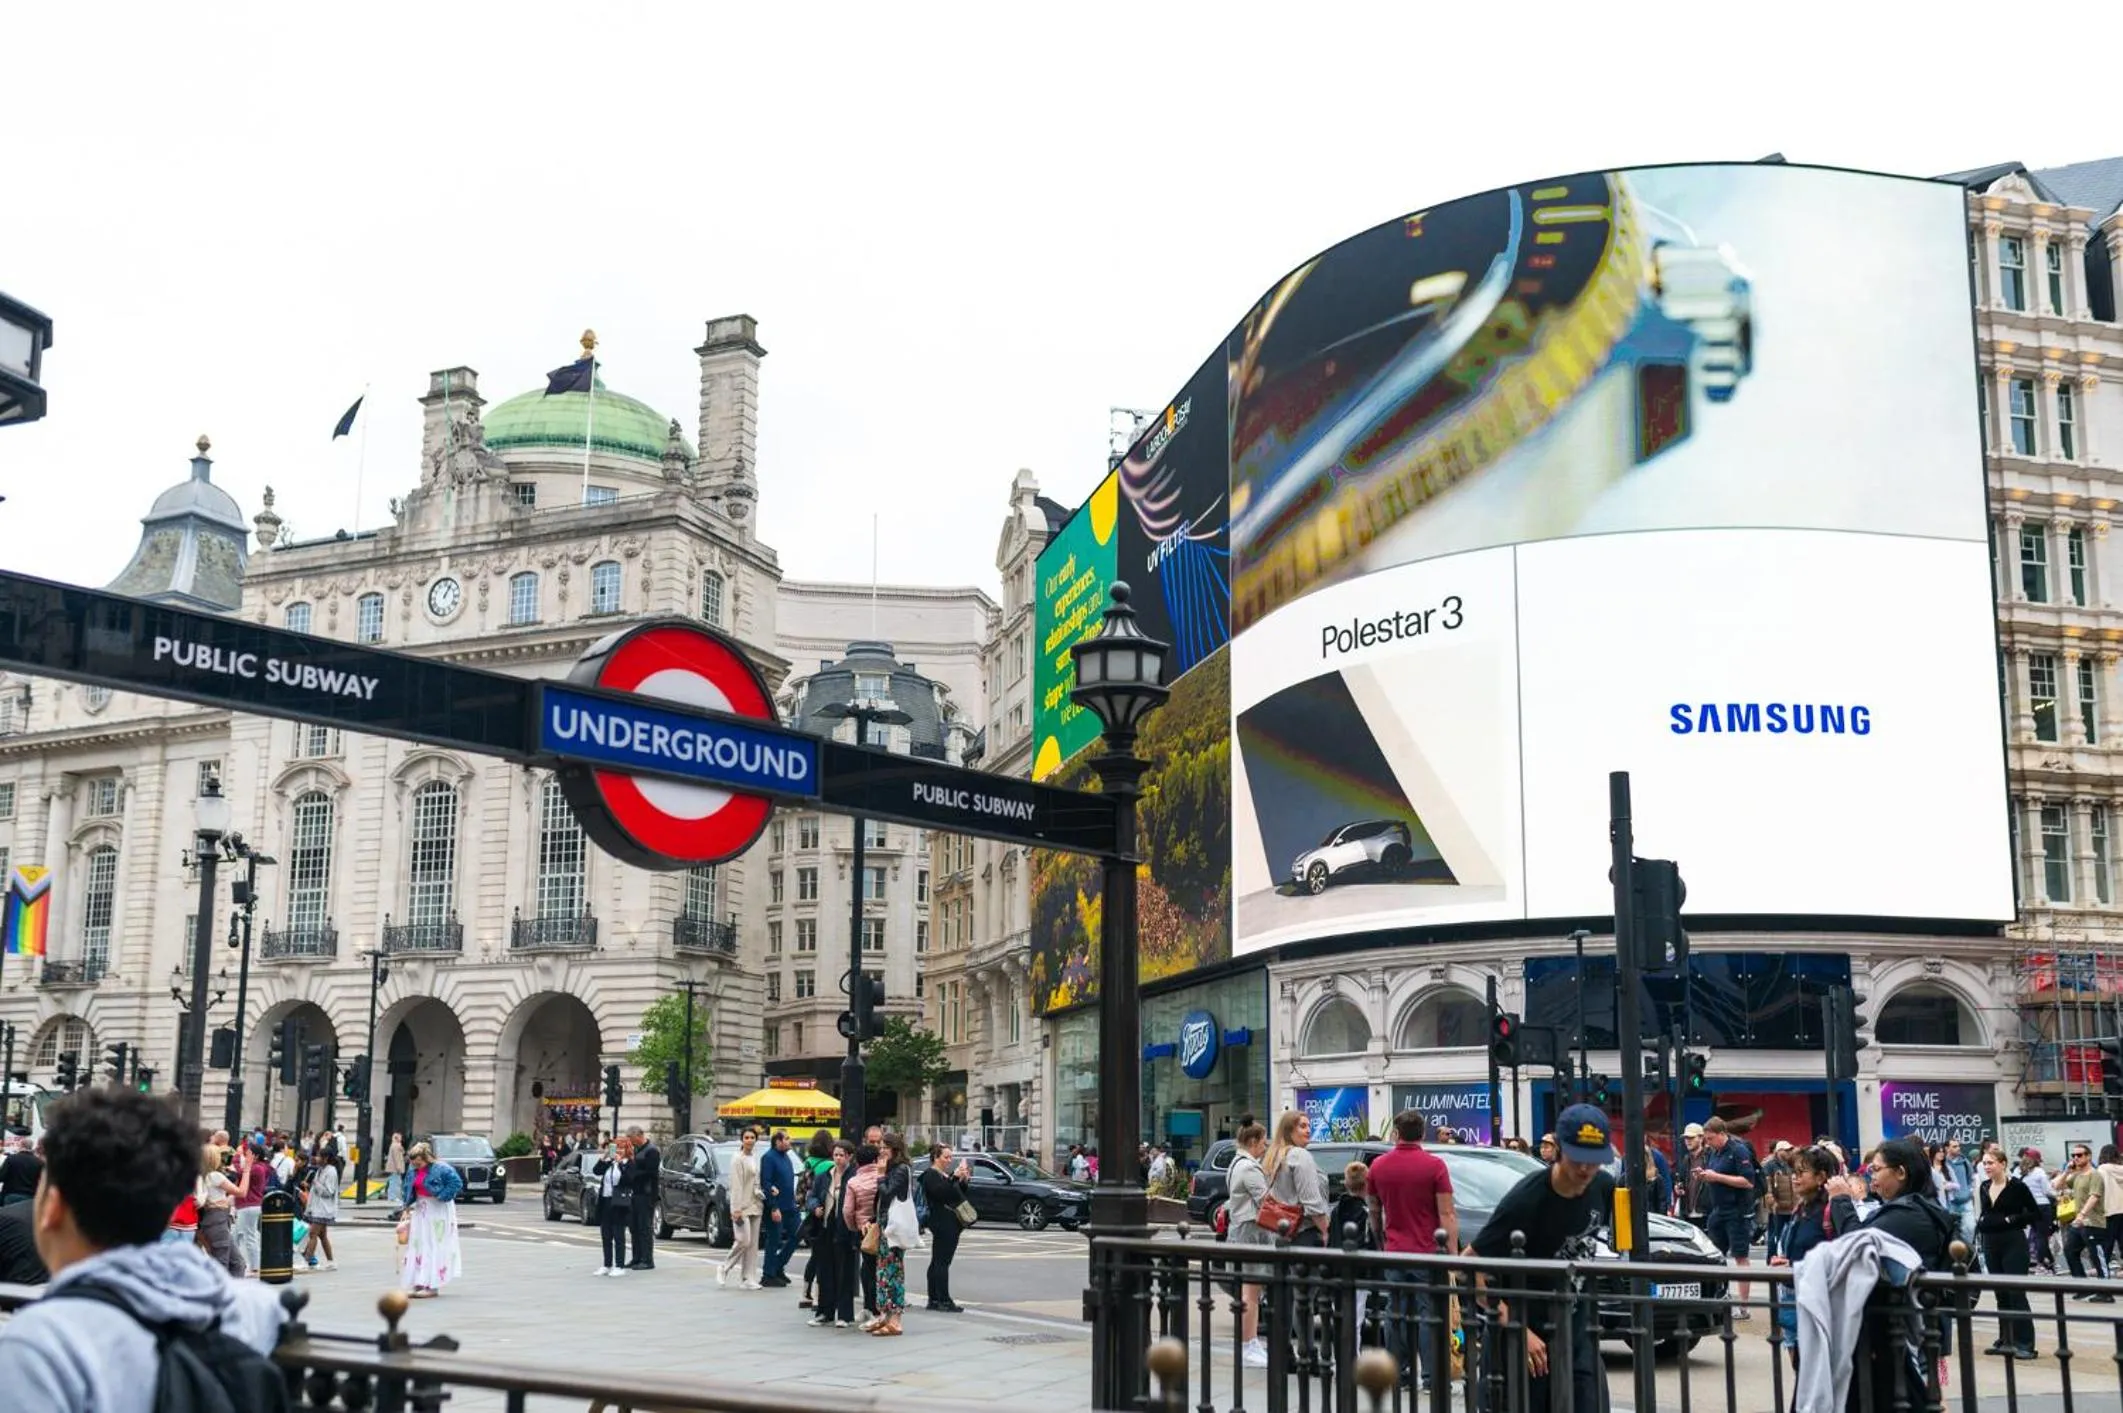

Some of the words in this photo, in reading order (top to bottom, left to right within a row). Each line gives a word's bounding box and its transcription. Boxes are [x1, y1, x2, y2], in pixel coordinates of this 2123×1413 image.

[1147, 543, 1161, 573] UV
[1160, 518, 1190, 563] FILTER
[1322, 608, 1437, 659] Polestar
[1442, 595, 1464, 630] 3
[153, 636, 259, 678] PUBLIC
[264, 657, 379, 701] SUBWAY
[1670, 702, 1871, 736] SAMSUNG
[552, 704, 808, 781] UNDERGROUND
[913, 781, 970, 810] PUBLIC
[972, 793, 1035, 822] SUBWAY
[1181, 1021, 1209, 1067] Boots
[1431, 1114, 1448, 1127] an
[1893, 1092, 1941, 1109] PRIME
[1902, 1110, 1935, 1127] retail
[1938, 1113, 1982, 1129] space
